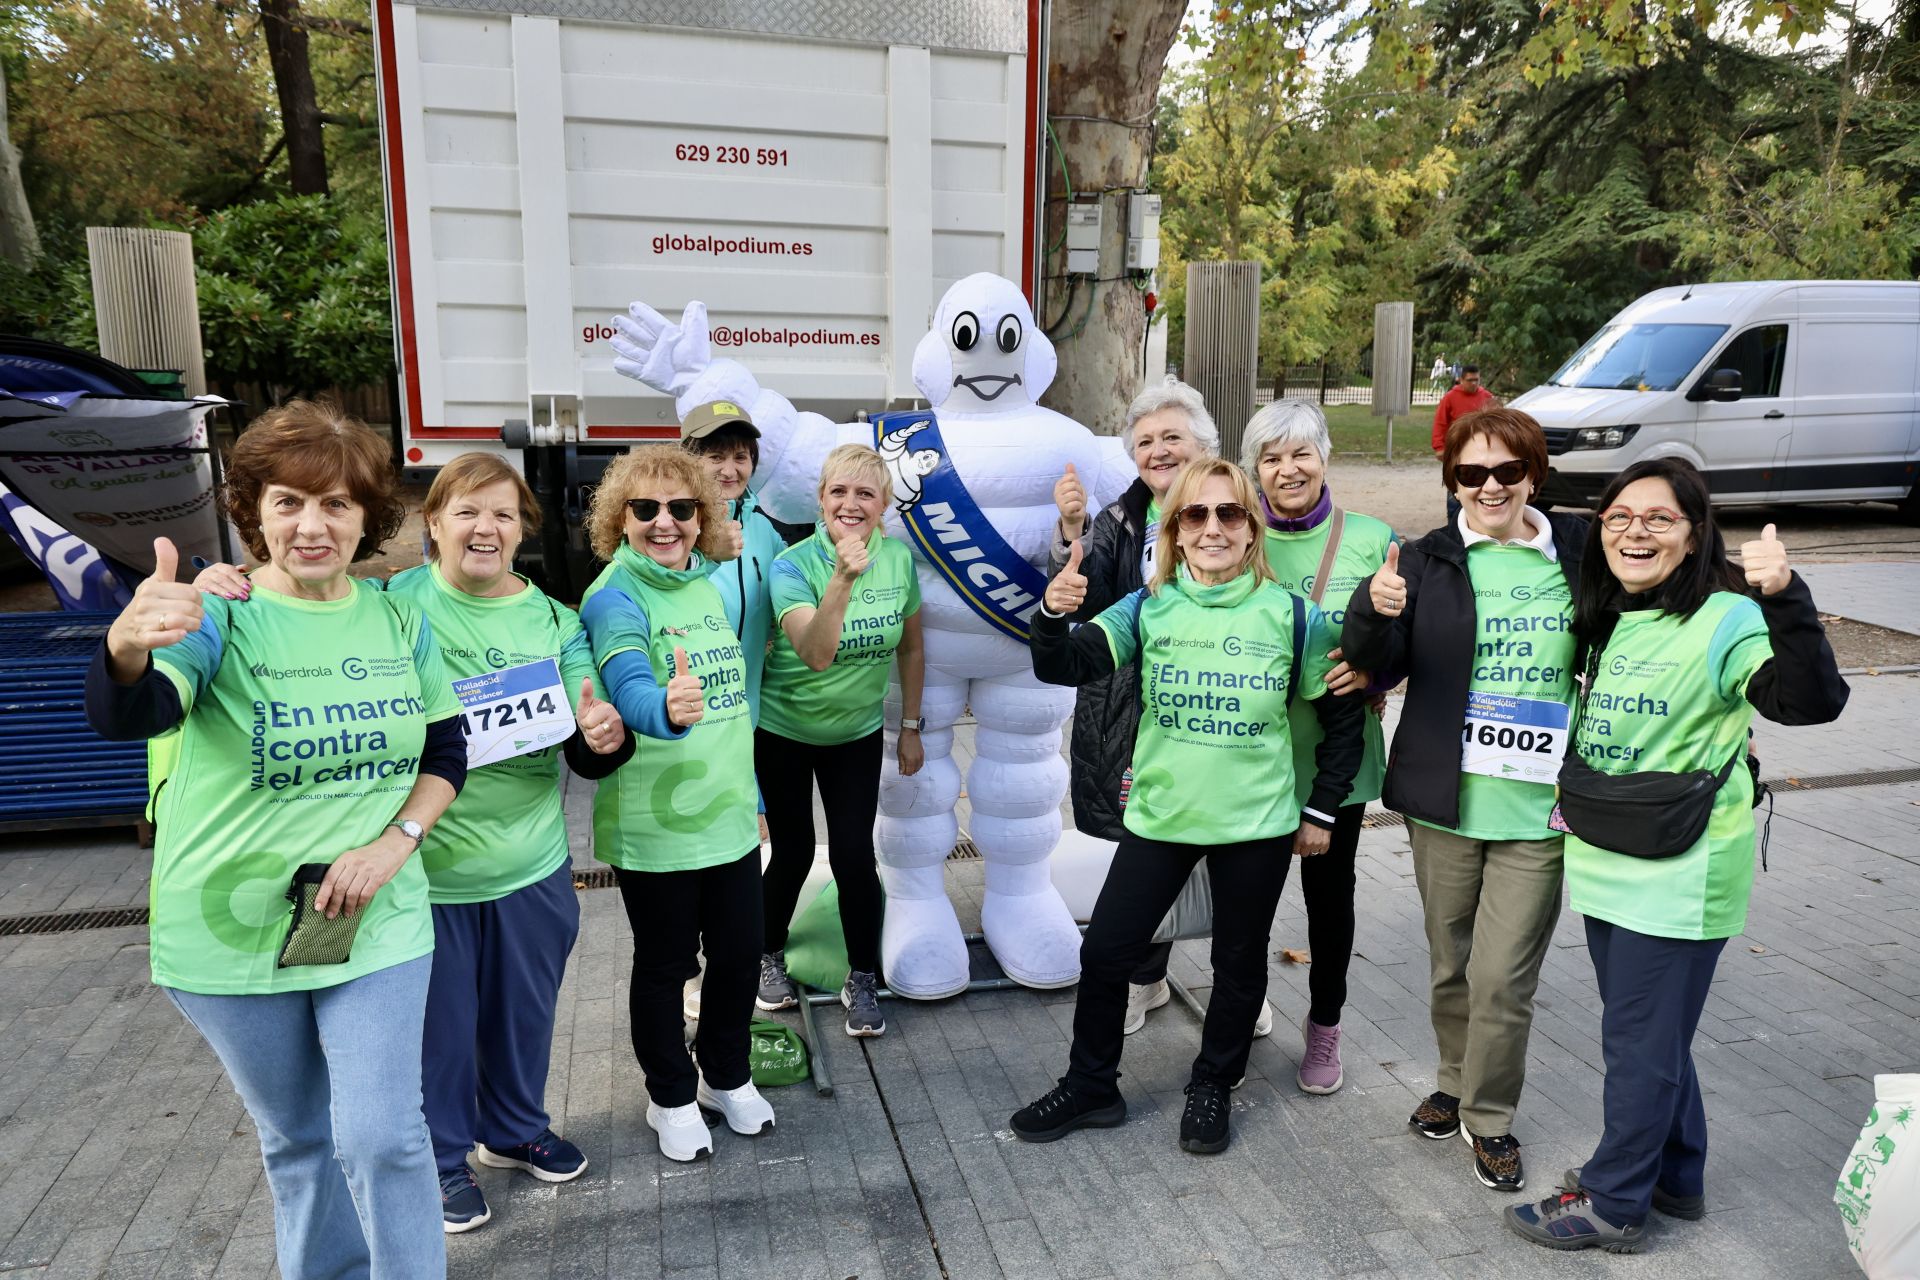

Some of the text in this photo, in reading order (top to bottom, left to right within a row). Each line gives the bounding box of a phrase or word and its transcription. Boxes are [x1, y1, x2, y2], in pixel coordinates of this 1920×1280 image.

[675, 144, 788, 167] 629 230 591
[652, 233, 813, 256] globalpodium.es
[62, 453, 191, 473] VALLADO
[921, 501, 1037, 625] MICH
[1475, 589, 1502, 598] drola
[851, 610, 904, 632] march
[1486, 612, 1572, 633] march
[838, 634, 885, 652] ontra
[844, 648, 895, 661] cánce
[1173, 637, 1215, 649] Iberdrola
[1477, 638, 1533, 657] ntra
[270, 665, 333, 680] Iberdrola
[698, 666, 741, 691] ontra
[1160, 664, 1287, 692] En marcha
[1474, 661, 1564, 683] cáncer
[271, 691, 426, 728] En march
[1158, 691, 1241, 713] contra
[1588, 692, 1668, 716] marcha
[458, 692, 556, 736] 17214
[1159, 710, 1269, 737] el cáncer
[1583, 712, 1612, 737] ntra
[251, 700, 266, 792] VALLADOLID
[269, 729, 388, 762] contra
[1462, 722, 1553, 754] 16002
[1577, 736, 1645, 761] áncer
[269, 756, 419, 791] el cáncer
[334, 791, 363, 800] MARCHA
